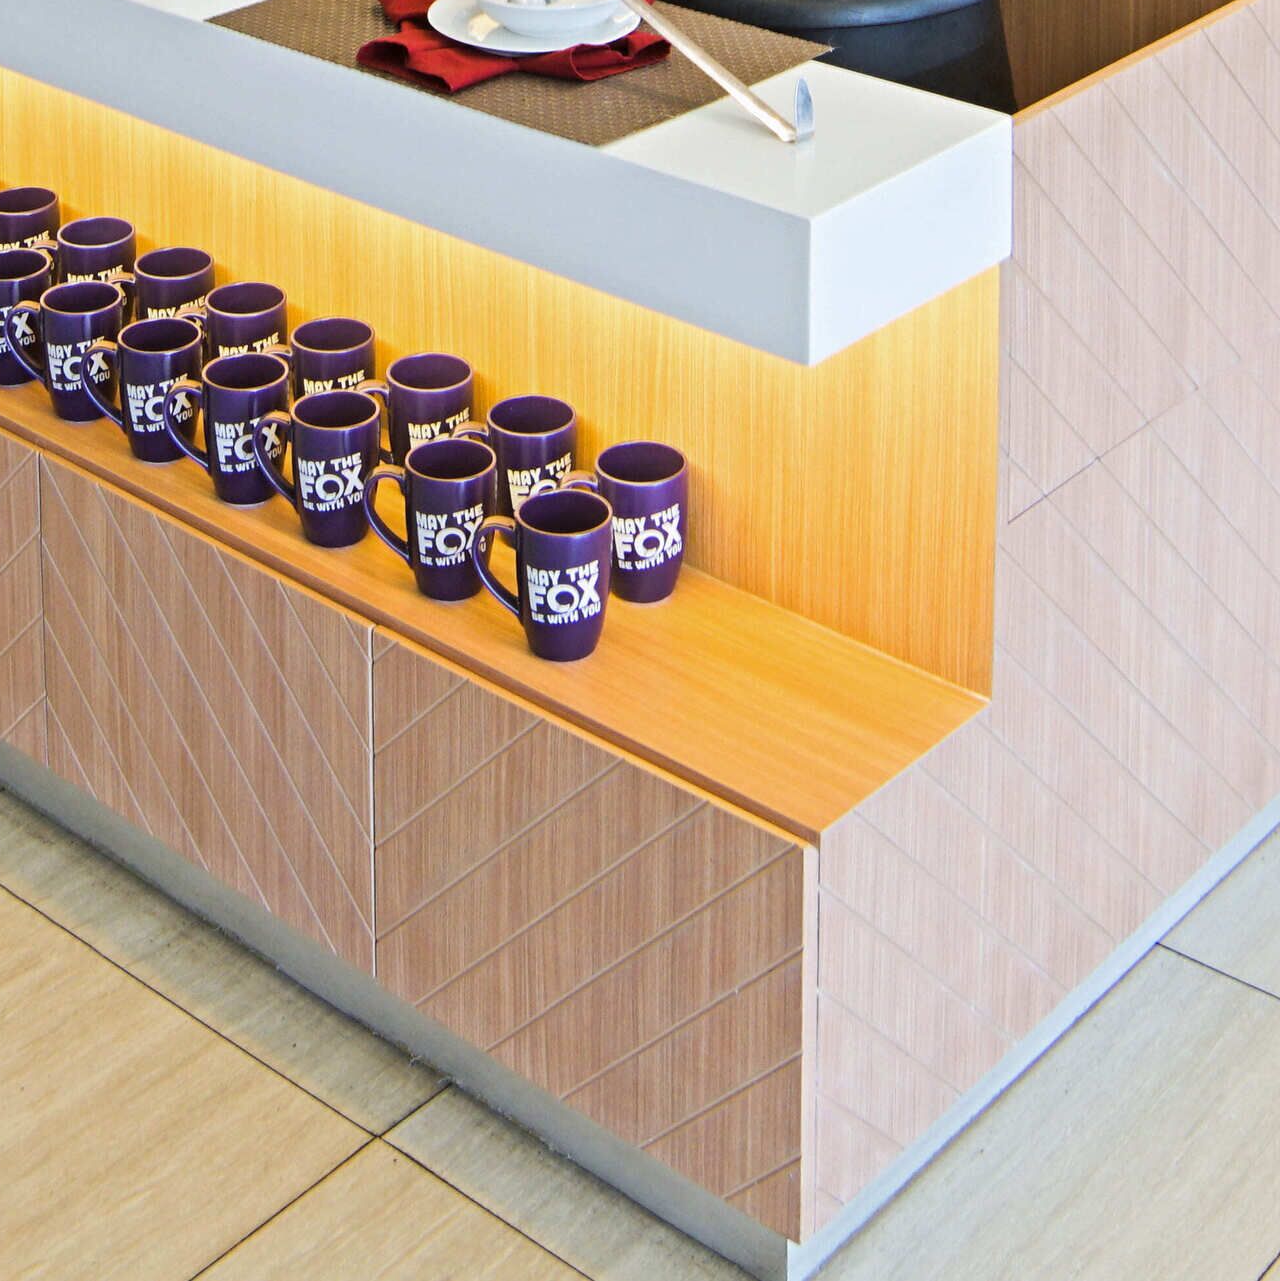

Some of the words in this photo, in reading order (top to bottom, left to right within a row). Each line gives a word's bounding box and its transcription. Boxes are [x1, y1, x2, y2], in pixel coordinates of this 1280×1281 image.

[47, 341, 72, 359] MAY
[127, 384, 155, 400] MAY
[304, 379, 333, 396] MAY
[338, 369, 365, 389] THE
[177, 409, 193, 423] YOU
[408, 422, 442, 440] MAY
[446, 407, 470, 430] THE
[215, 422, 245, 439] MAY
[298, 456, 326, 476] MAY
[330, 452, 362, 472] THE
[507, 467, 541, 486] MAY
[545, 452, 571, 476] THE
[300, 464, 364, 500] FOX
[316, 498, 344, 512] WITH
[415, 510, 448, 530] MAY
[452, 503, 483, 525] THE
[612, 515, 646, 535] MAY
[650, 503, 679, 528] THE
[614, 514, 681, 559] FOX
[435, 551, 466, 567] WITH
[634, 552, 664, 570] WITH
[666, 540, 682, 560] YOU
[526, 564, 561, 587] MAY
[565, 559, 599, 583] THE
[528, 573, 601, 613] FOX
[546, 608, 579, 625] WITH
[581, 600, 601, 618] YOU
